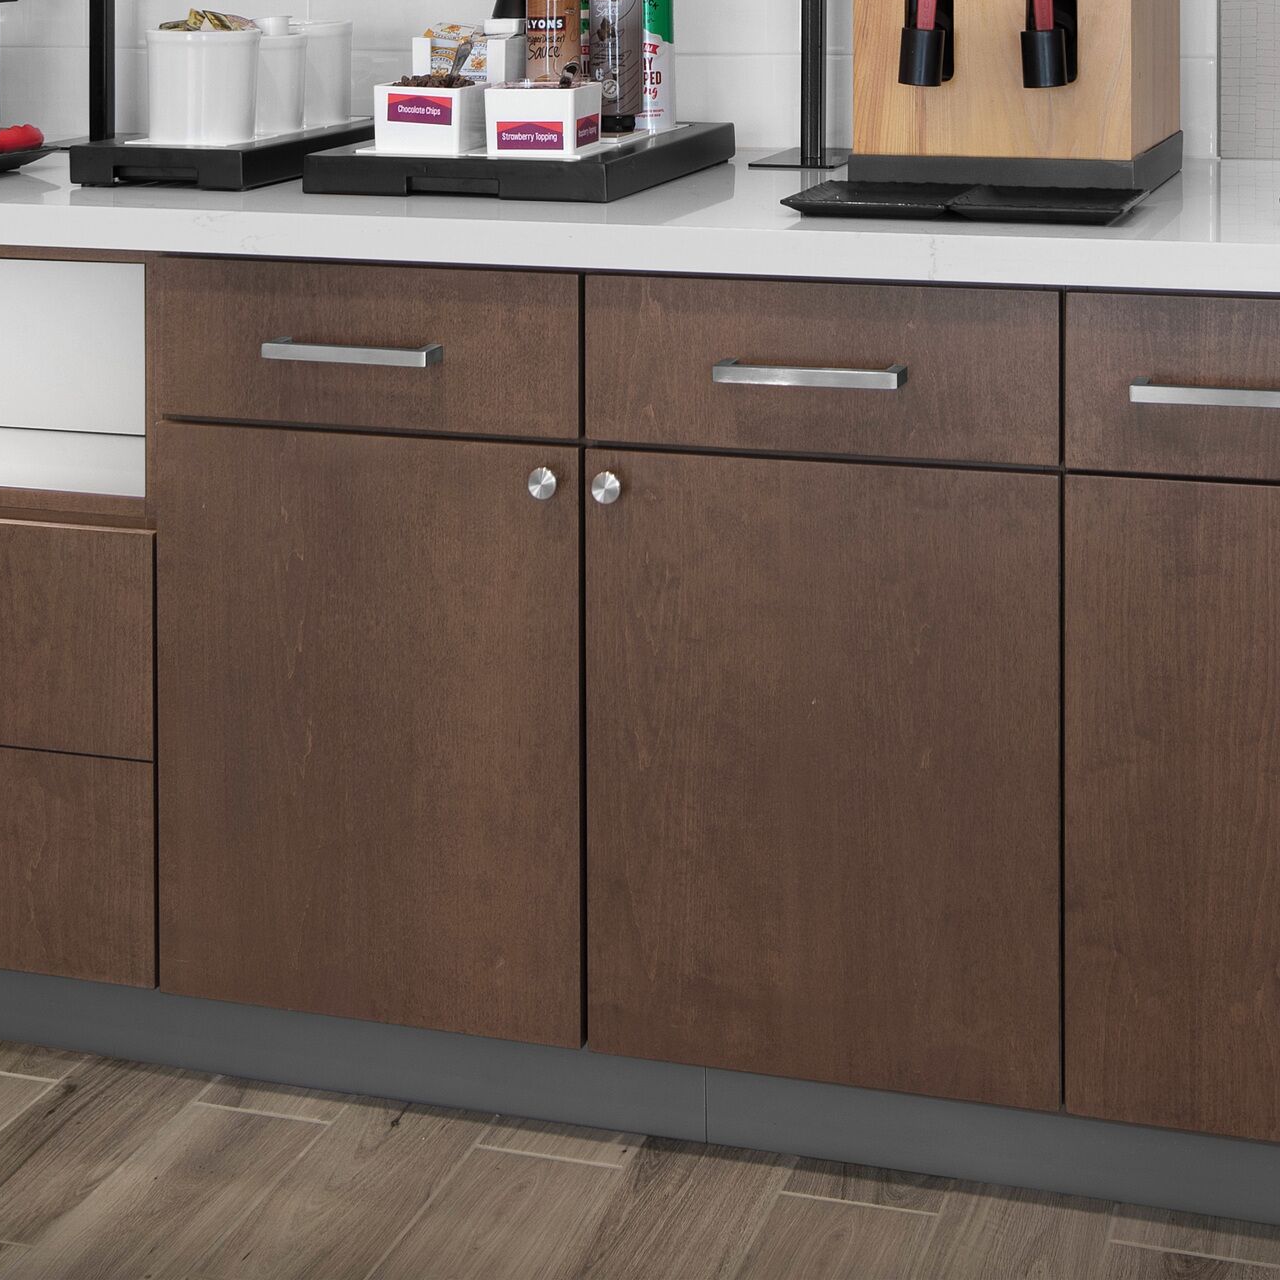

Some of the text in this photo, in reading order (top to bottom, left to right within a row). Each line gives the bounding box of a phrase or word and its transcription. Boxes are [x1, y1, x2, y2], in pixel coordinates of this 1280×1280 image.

[527, 19, 563, 29] LYONS
[397, 105, 441, 117] Chocolate Chips
[502, 132, 558, 143] Strawberry Topping
